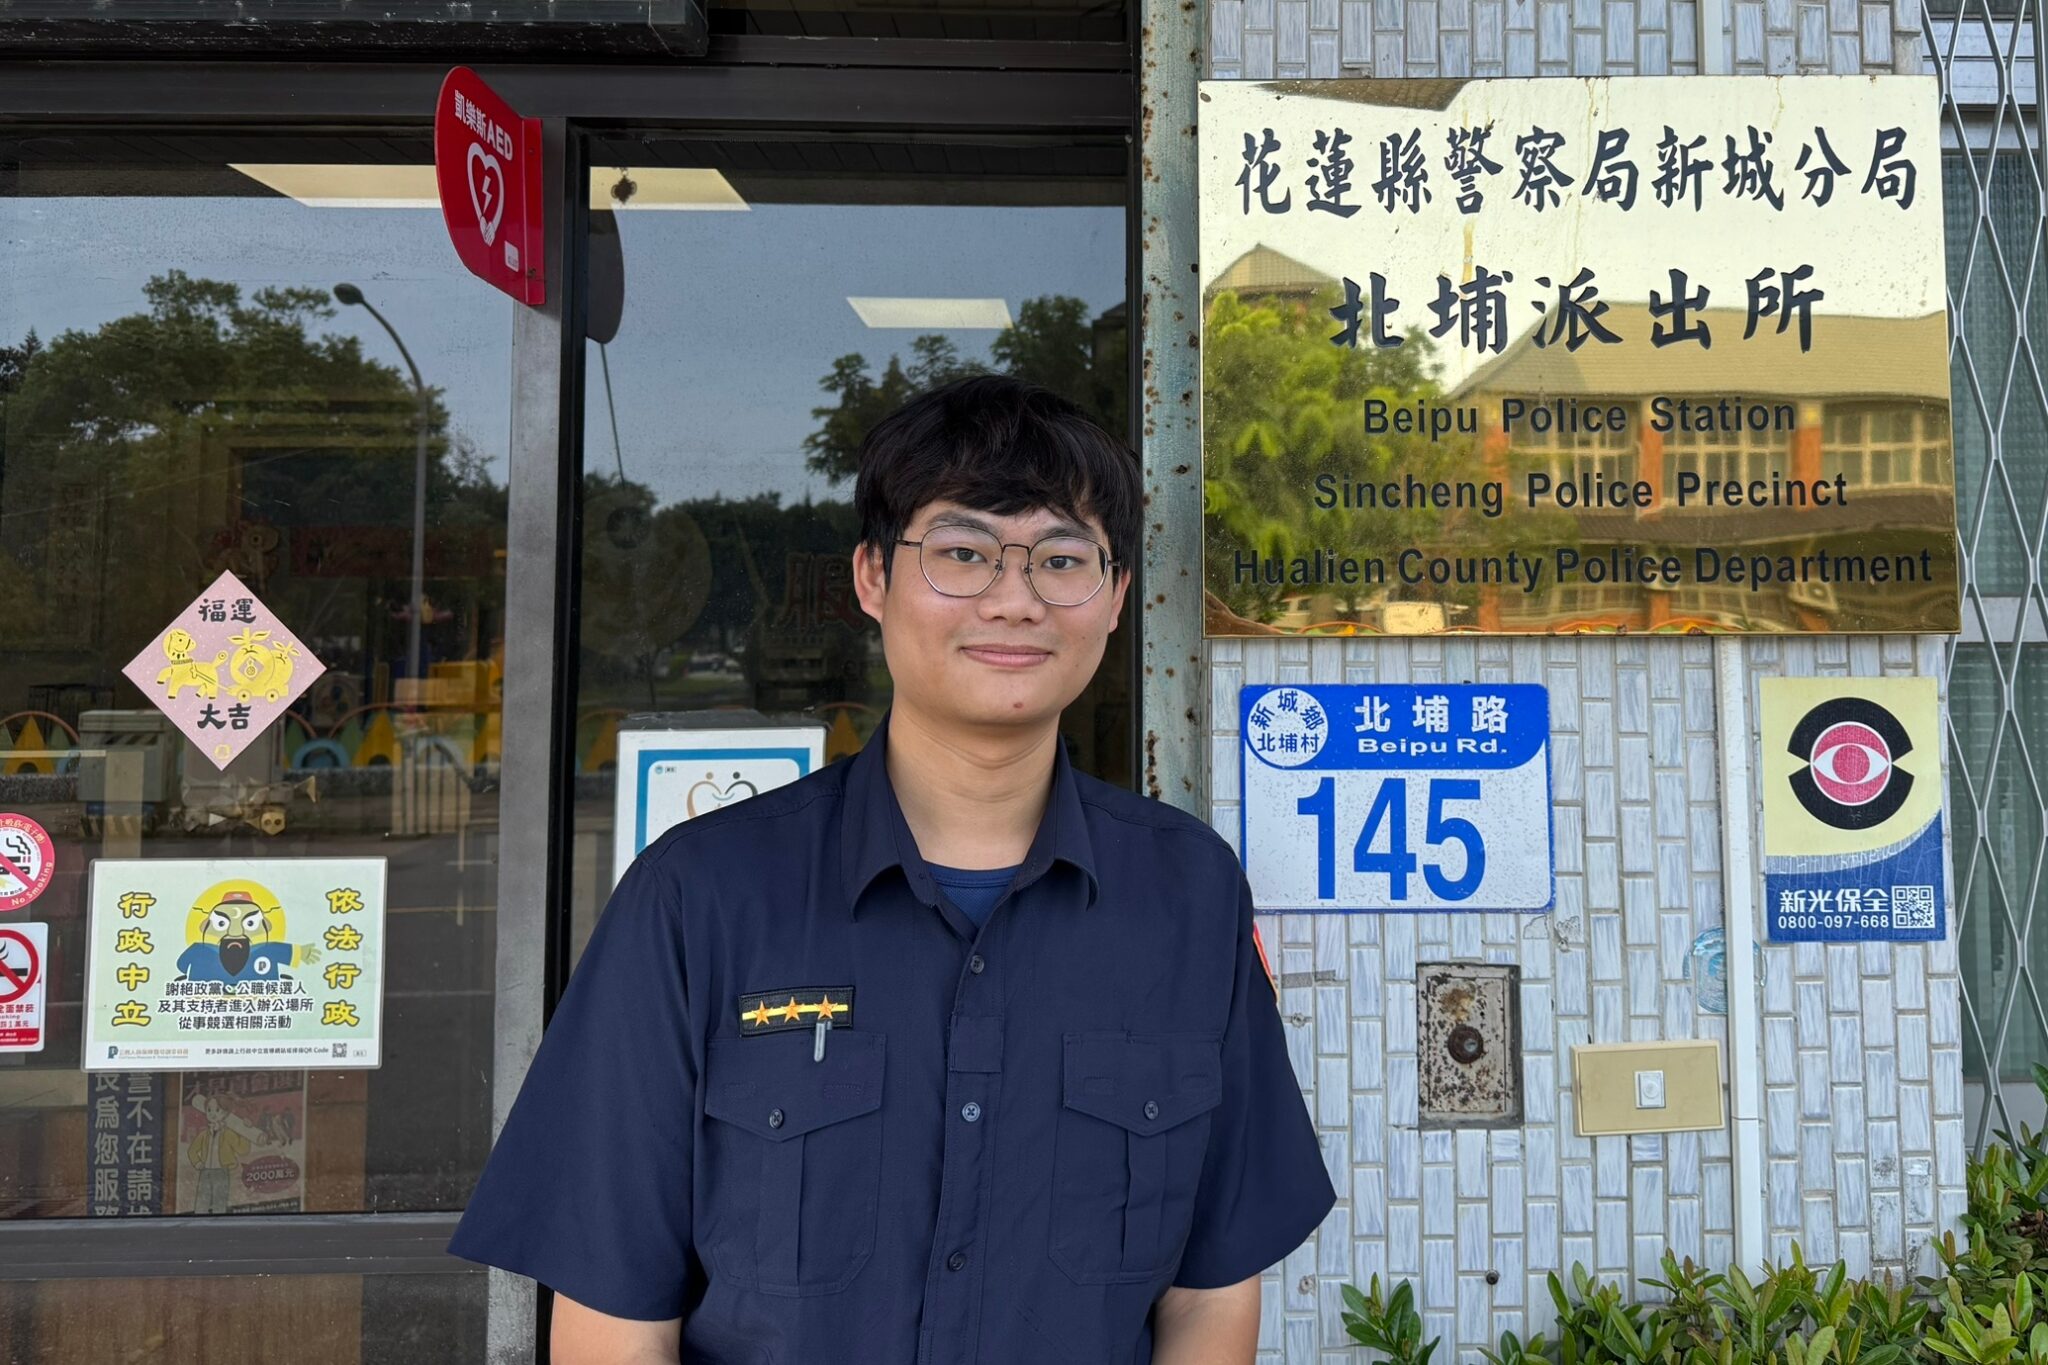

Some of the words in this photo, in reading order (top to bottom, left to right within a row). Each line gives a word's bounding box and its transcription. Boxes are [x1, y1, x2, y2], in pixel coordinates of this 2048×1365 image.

[1235, 125, 1917, 218] 花蓮縣警察局新城分局
[1329, 264, 1825, 354] 北埔派出所
[1364, 399, 1477, 442] Beipu
[1502, 398, 1627, 433] Police
[1650, 397, 1795, 432] Station
[1314, 473, 1503, 517] Sincheng
[1527, 472, 1653, 508] Police
[1677, 471, 1847, 507] Precinct
[1234, 549, 1385, 585] Hualien
[1399, 548, 1542, 592] County
[1556, 547, 1682, 584] Police
[1695, 547, 1932, 591] Department
[198, 598, 256, 624] 福運
[197, 703, 252, 730] 大吉
[1250, 691, 1325, 731] 新城鄉
[1354, 695, 1509, 733] 北埔路
[1257, 732, 1320, 753] 北埔村
[1358, 738, 1448, 756] Beipu
[1456, 738, 1508, 753] Rd.
[1297, 776, 1486, 901] 145
[11, 897, 26, 906] No
[27, 861, 53, 898] Smoking
[1779, 888, 1889, 913] 新光保全
[1778, 915, 1889, 929] 0800-097-668
[112, 891, 156, 1027] 行政中立
[321, 888, 364, 1027] 依法行政
[157, 998, 314, 1014] 及其支持者進入辦公場所
[165, 982, 307, 997] 謝絕政黨、公職候選人
[178, 1015, 292, 1030] 從事競選相關活動
